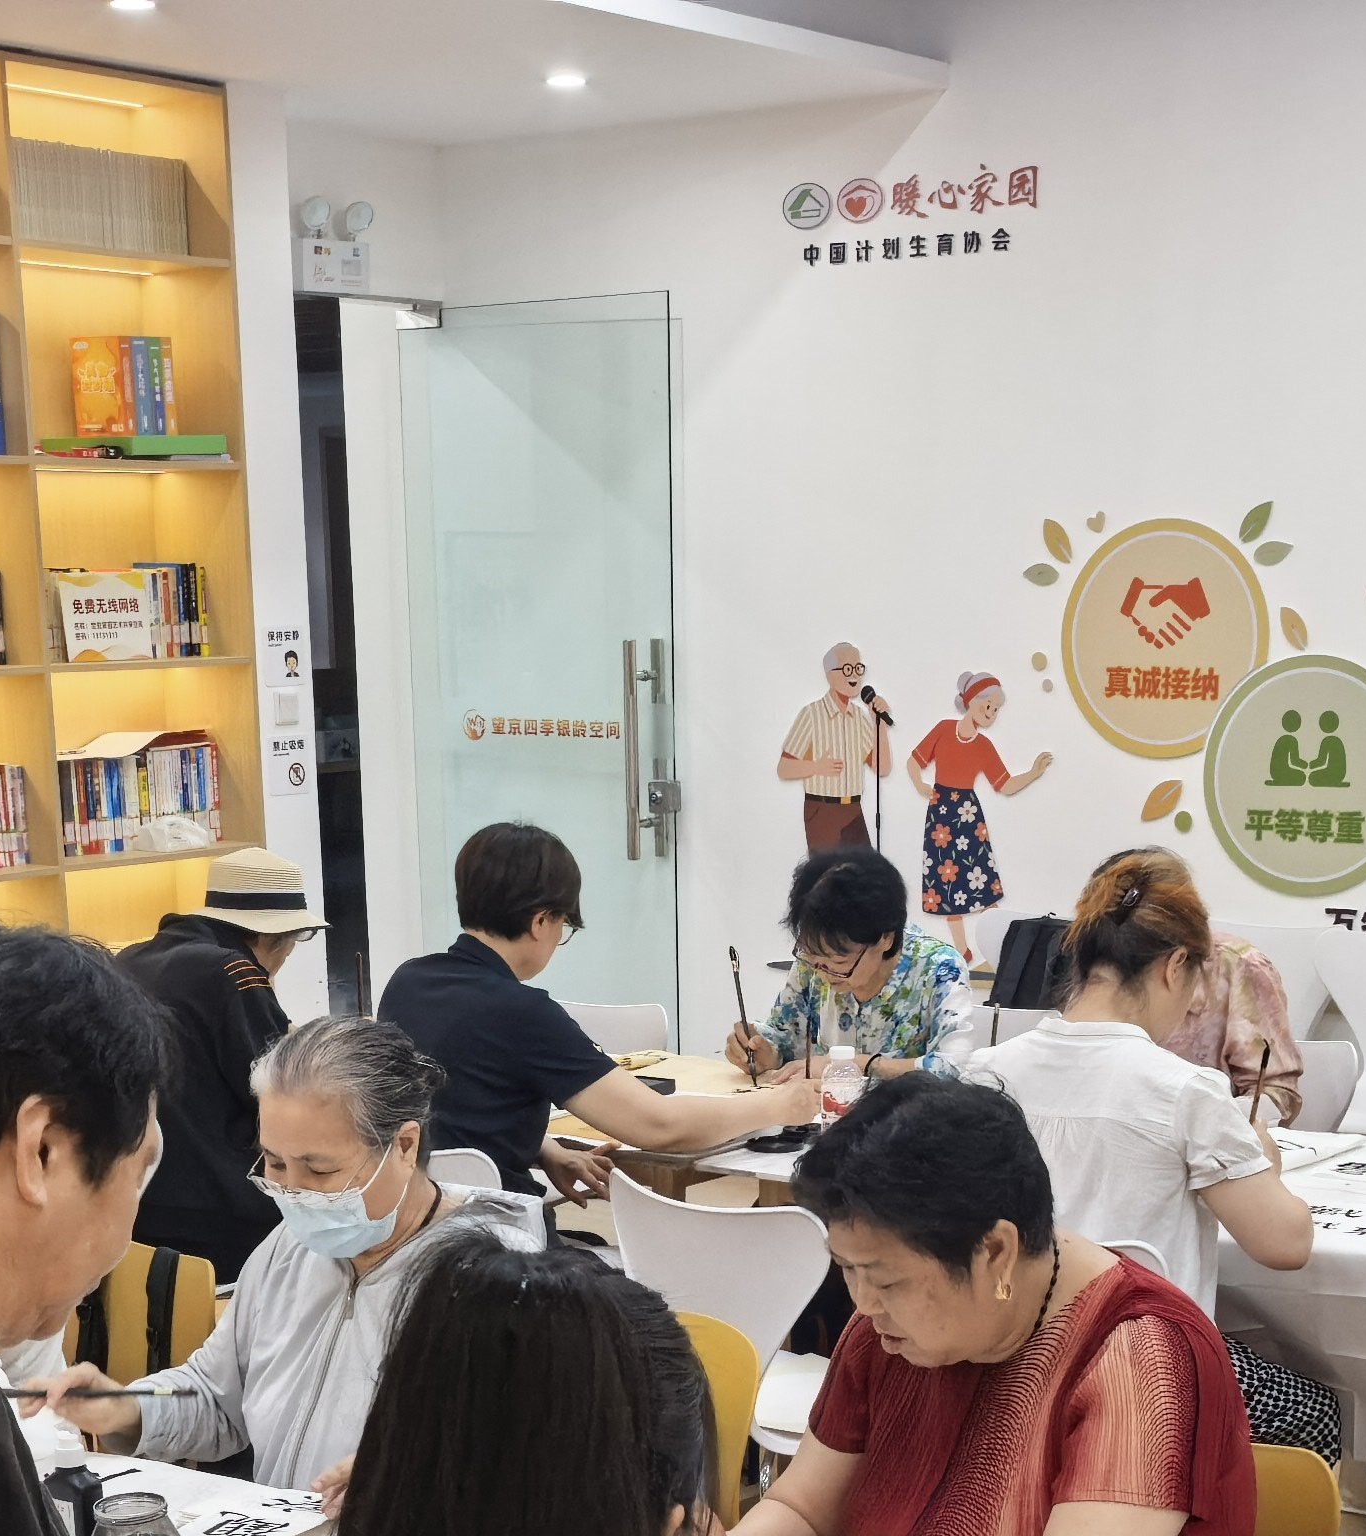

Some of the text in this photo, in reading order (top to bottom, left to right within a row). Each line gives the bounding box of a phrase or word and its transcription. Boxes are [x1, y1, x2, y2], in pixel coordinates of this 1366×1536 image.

[890, 164, 1039, 219] 暖心家园
[803, 228, 1011, 266] 中国计划生育协会
[73, 598, 139, 614] 免费无线网络
[1104, 666, 1220, 701] 真诚接纳
[491, 716, 621, 739] 望京四季银龄空间
[1244, 808, 1365, 843] 平等尊重
